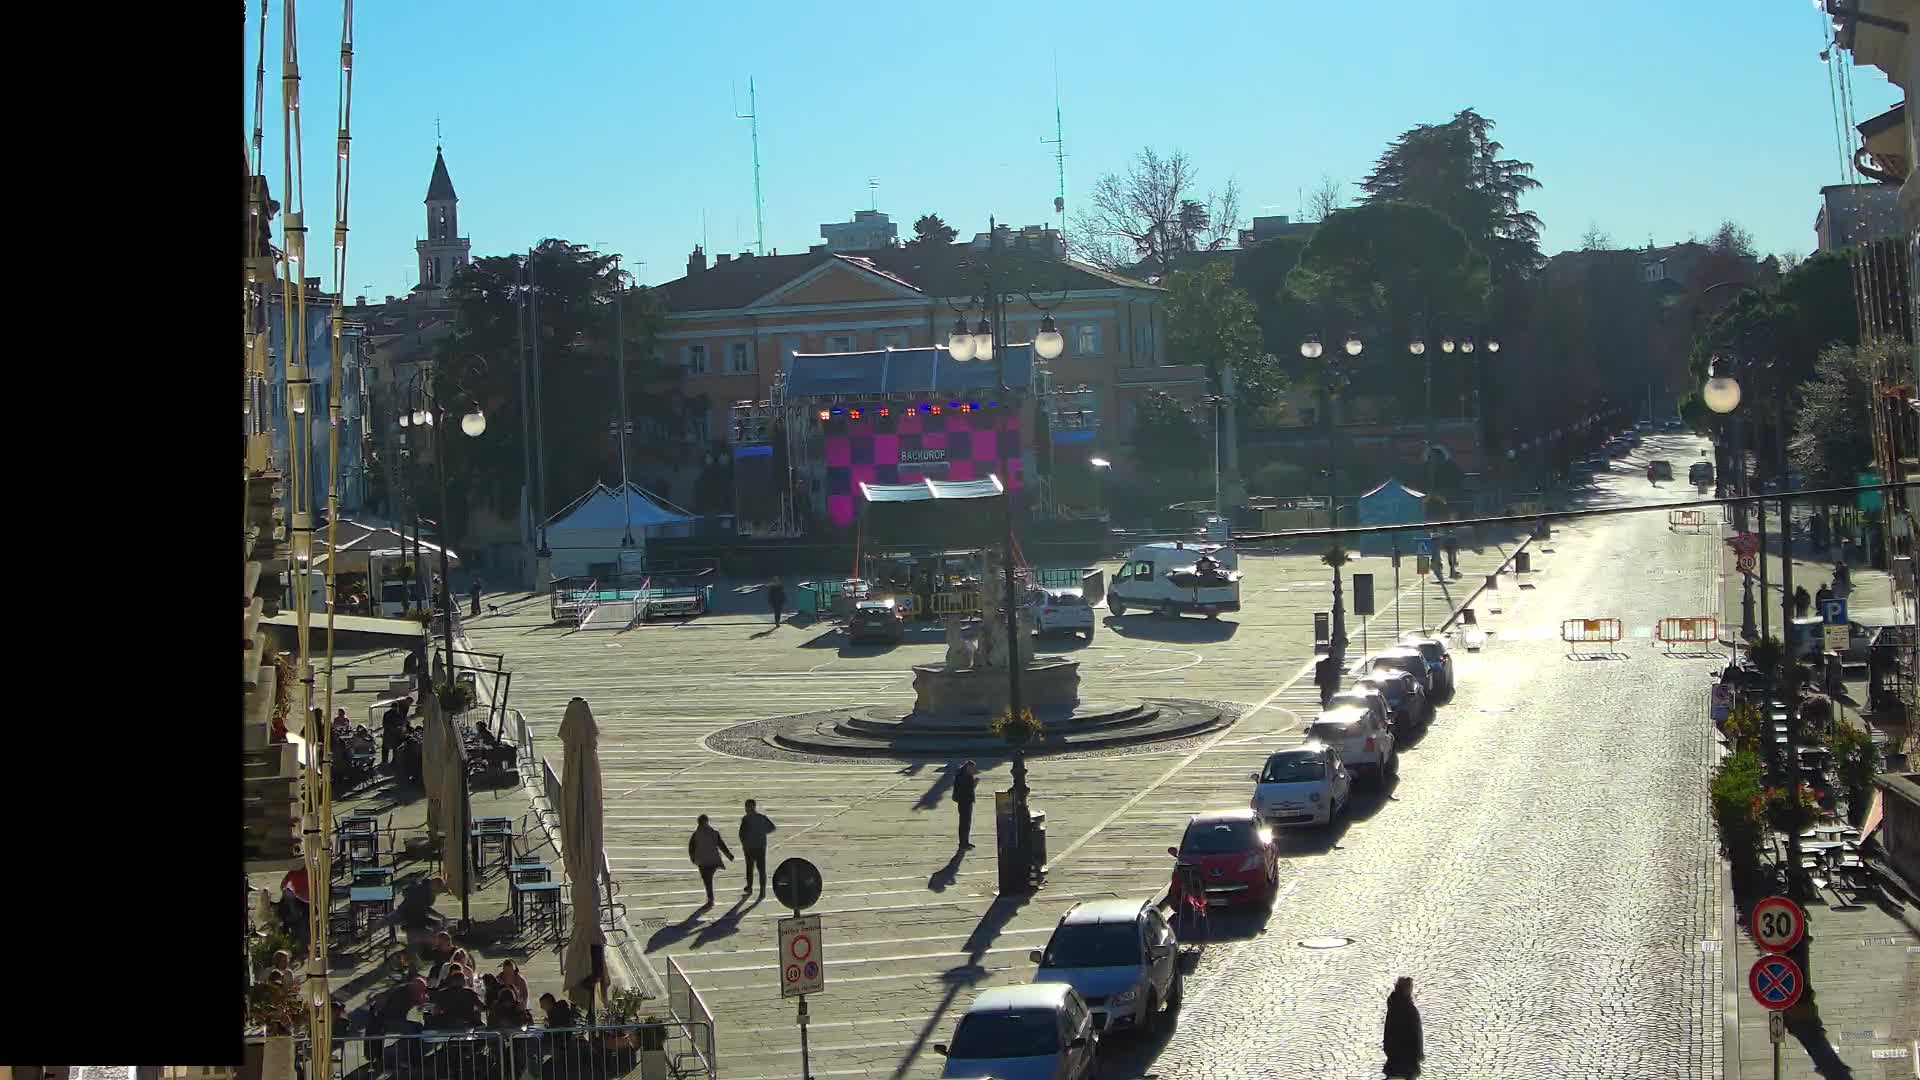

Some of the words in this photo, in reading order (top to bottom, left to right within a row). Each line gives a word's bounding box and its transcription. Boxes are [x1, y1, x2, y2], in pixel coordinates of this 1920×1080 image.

[901, 450, 945, 461] BACKDROP
[1827, 602, 1841, 620] P
[1762, 912, 1791, 937] 30
